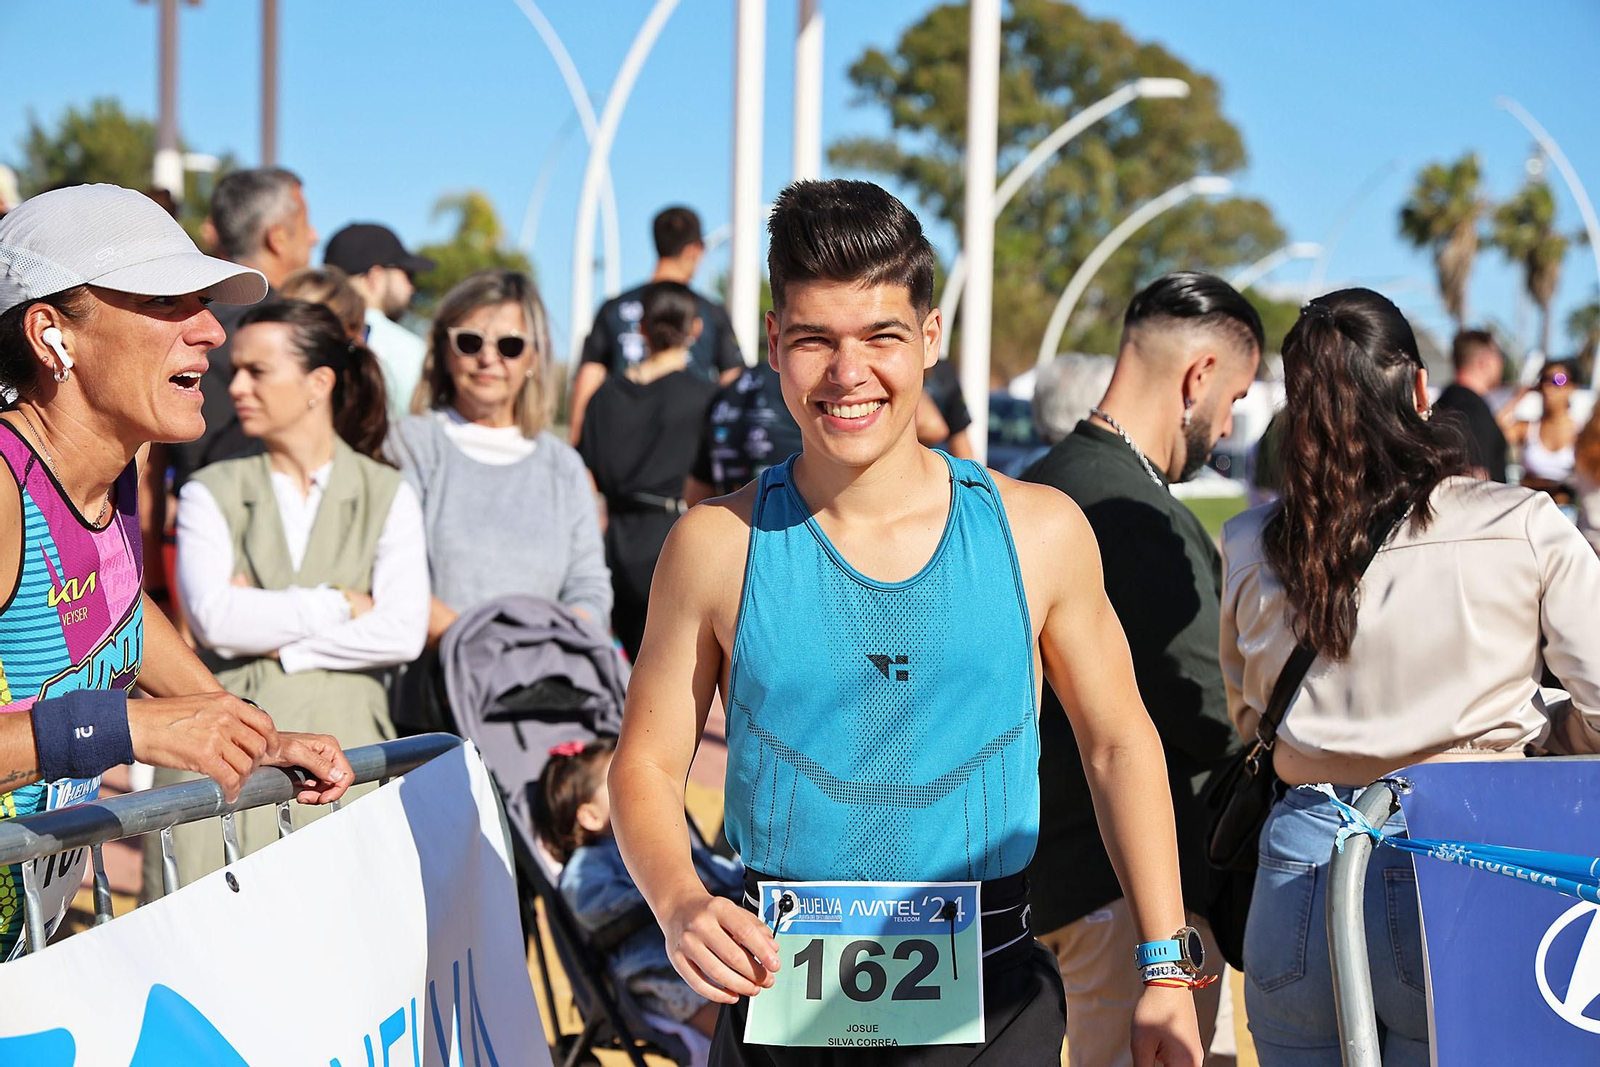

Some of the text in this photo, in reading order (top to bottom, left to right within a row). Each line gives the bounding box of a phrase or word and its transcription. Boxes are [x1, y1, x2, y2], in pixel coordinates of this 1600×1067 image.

[62, 606, 89, 627] VEYSER
[798, 897, 842, 915] HUELVA
[849, 899, 920, 917] AVATEL
[793, 938, 941, 1002] 162
[846, 1024, 879, 1034] JOSUE
[828, 1037, 899, 1048] SILVA CORREA
